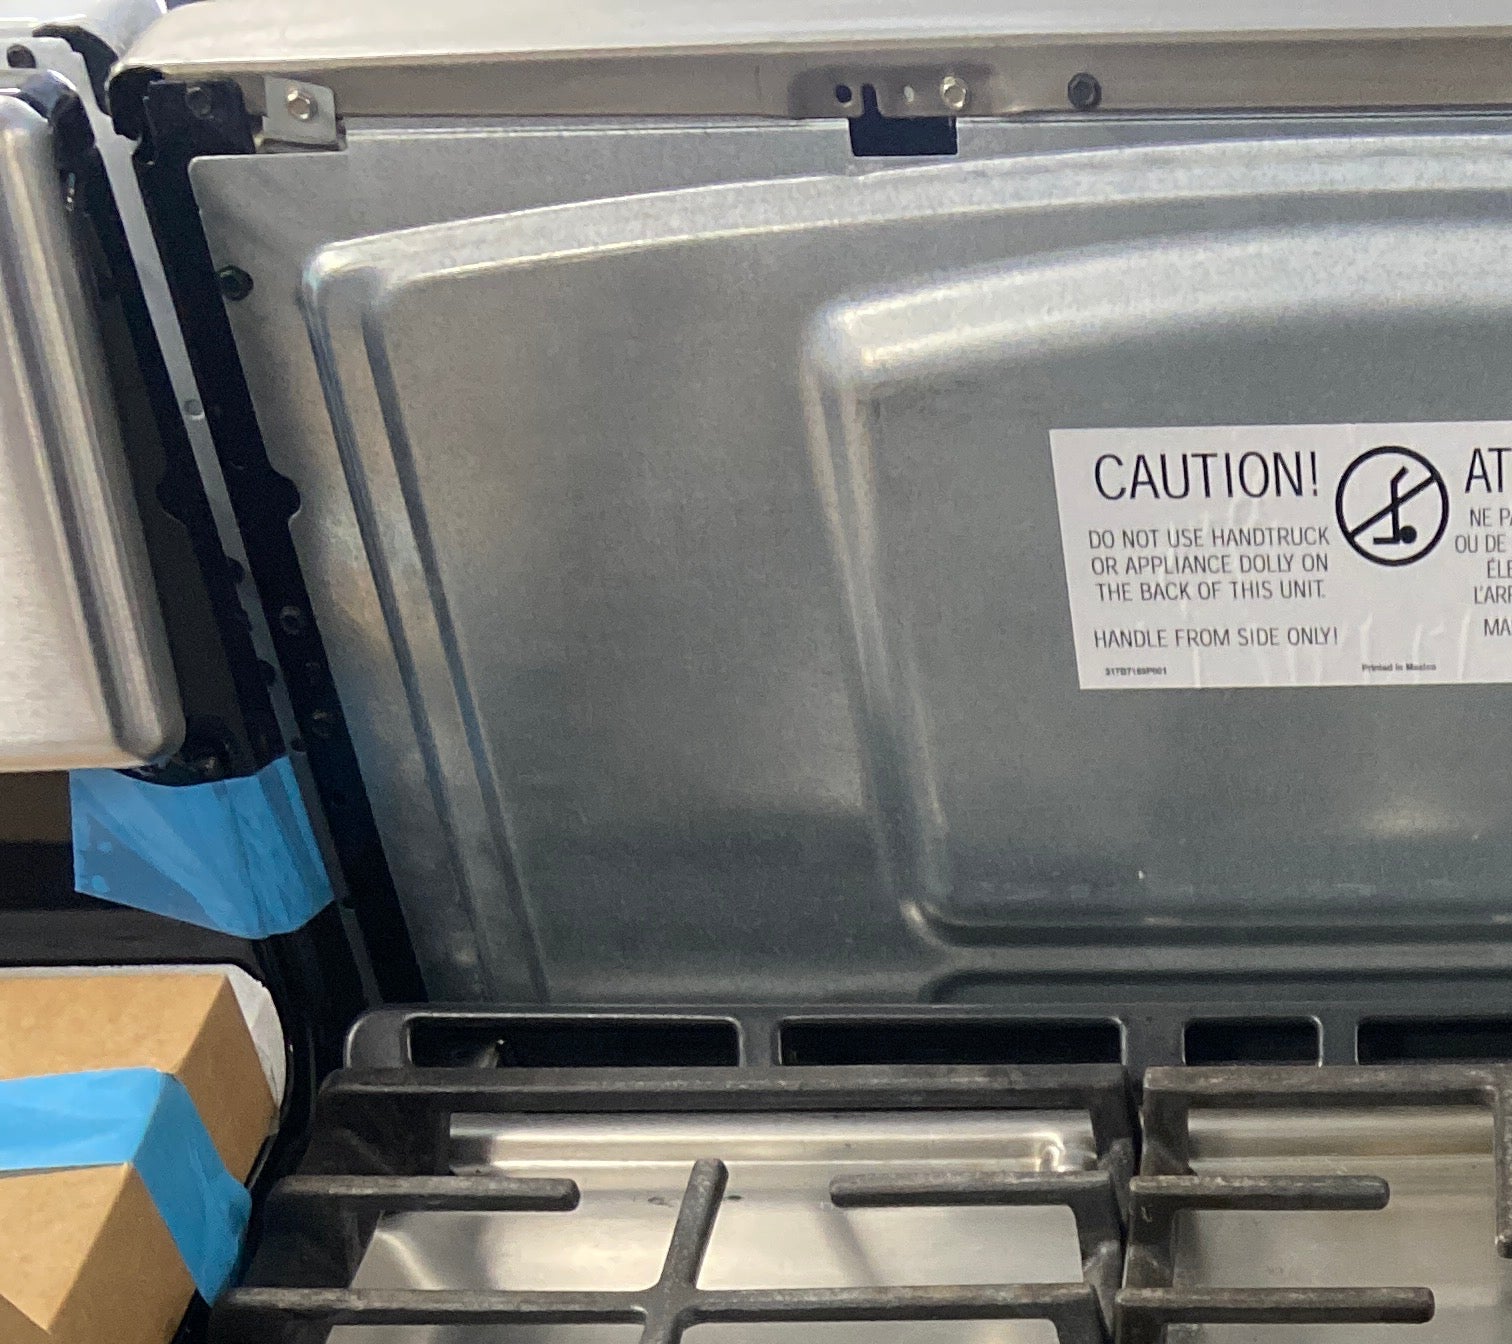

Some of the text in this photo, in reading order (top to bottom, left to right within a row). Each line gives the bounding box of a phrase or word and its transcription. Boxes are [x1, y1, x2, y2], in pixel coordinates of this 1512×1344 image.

[1095, 451, 1318, 500] CAUTION!
[1470, 508, 1492, 527] NE
[1089, 527, 1331, 549] DO NOT USE HANDTRUCK
[1455, 535, 1478, 553] OU
[1485, 534, 1506, 552] DE
[1091, 553, 1328, 576] OR APPLIANCE DOLLY ON
[1096, 580, 1326, 601] THE BACK OF THIS UNIT.
[1094, 627, 1338, 648] HANDLE FROM SIDE ONLY!
